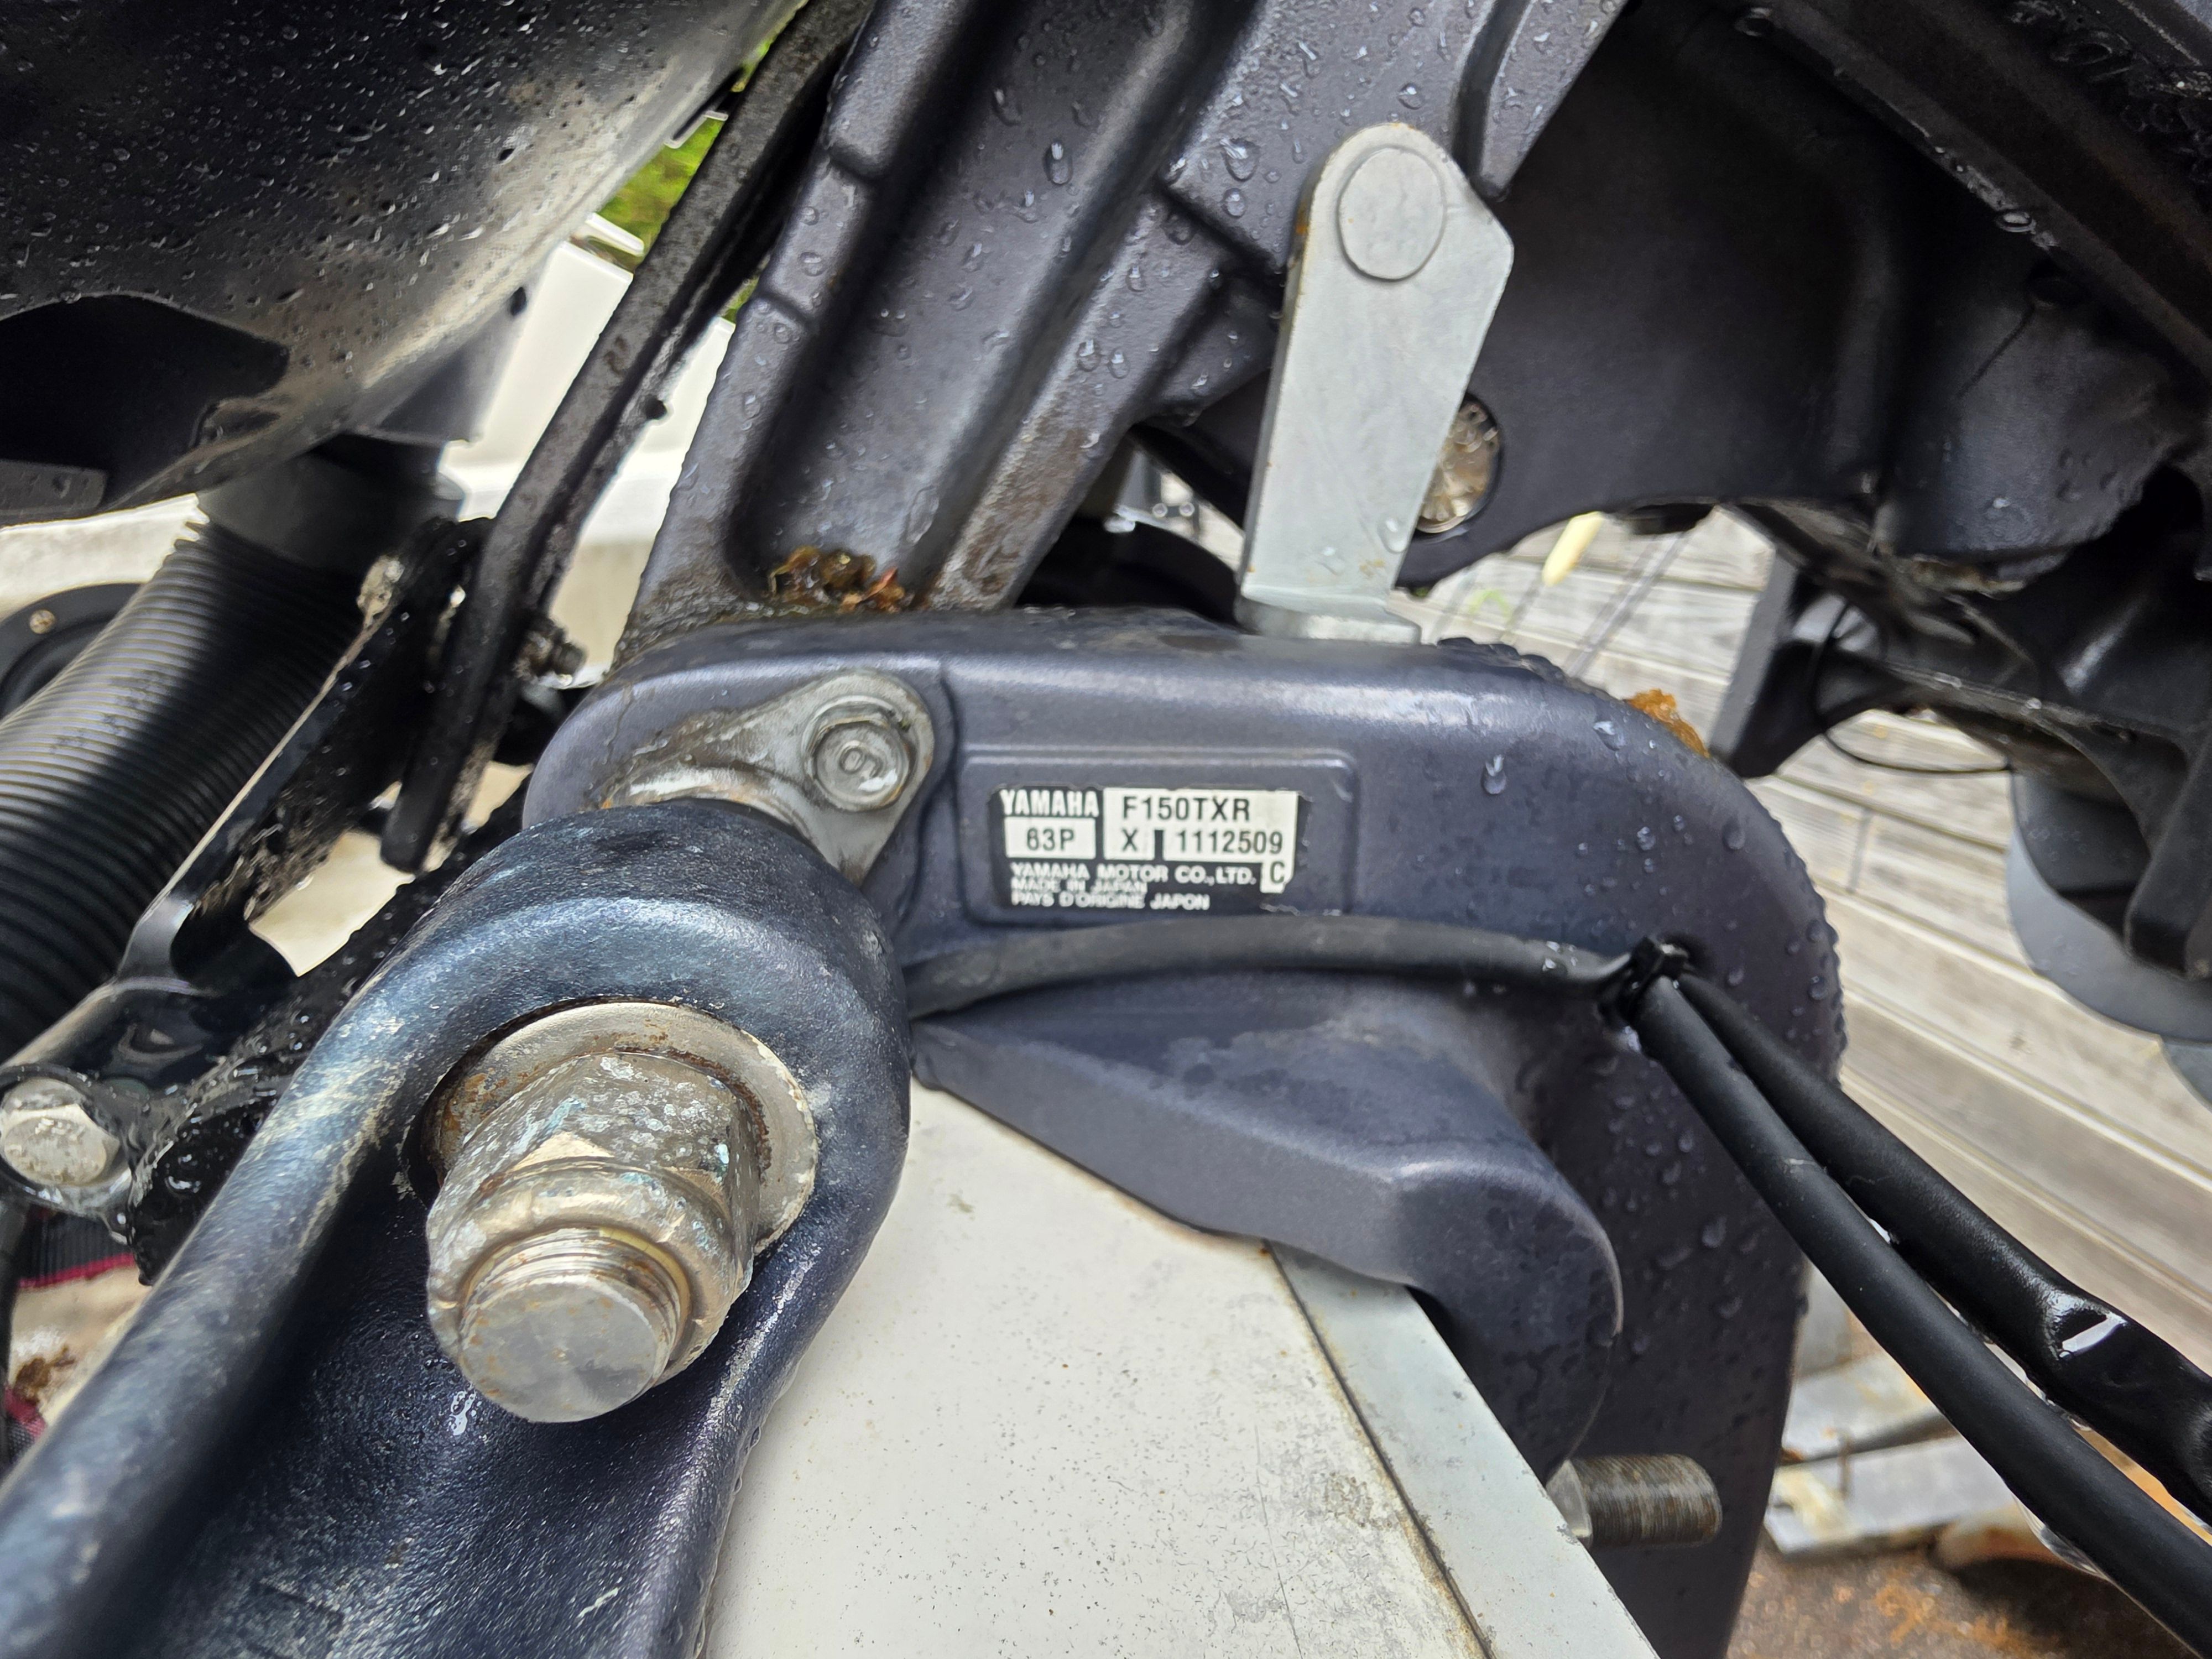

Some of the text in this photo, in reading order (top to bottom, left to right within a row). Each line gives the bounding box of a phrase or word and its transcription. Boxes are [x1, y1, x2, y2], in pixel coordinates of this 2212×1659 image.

[999, 789, 1099, 817] YAMAHA
[1123, 796, 1250, 821] F150TXR
[1026, 827, 1074, 851] 63P
[1122, 829, 1138, 852] X
[1177, 830, 1284, 854] 1112509
[1010, 862, 1091, 880] YAMAHA
[1097, 863, 1168, 883] MOTOR
[1270, 860, 1285, 884] C
[1010, 877, 1147, 895] MADE IN JAPAN
[1011, 891, 1055, 907] PAYS
[1150, 893, 1210, 910] JAPON
